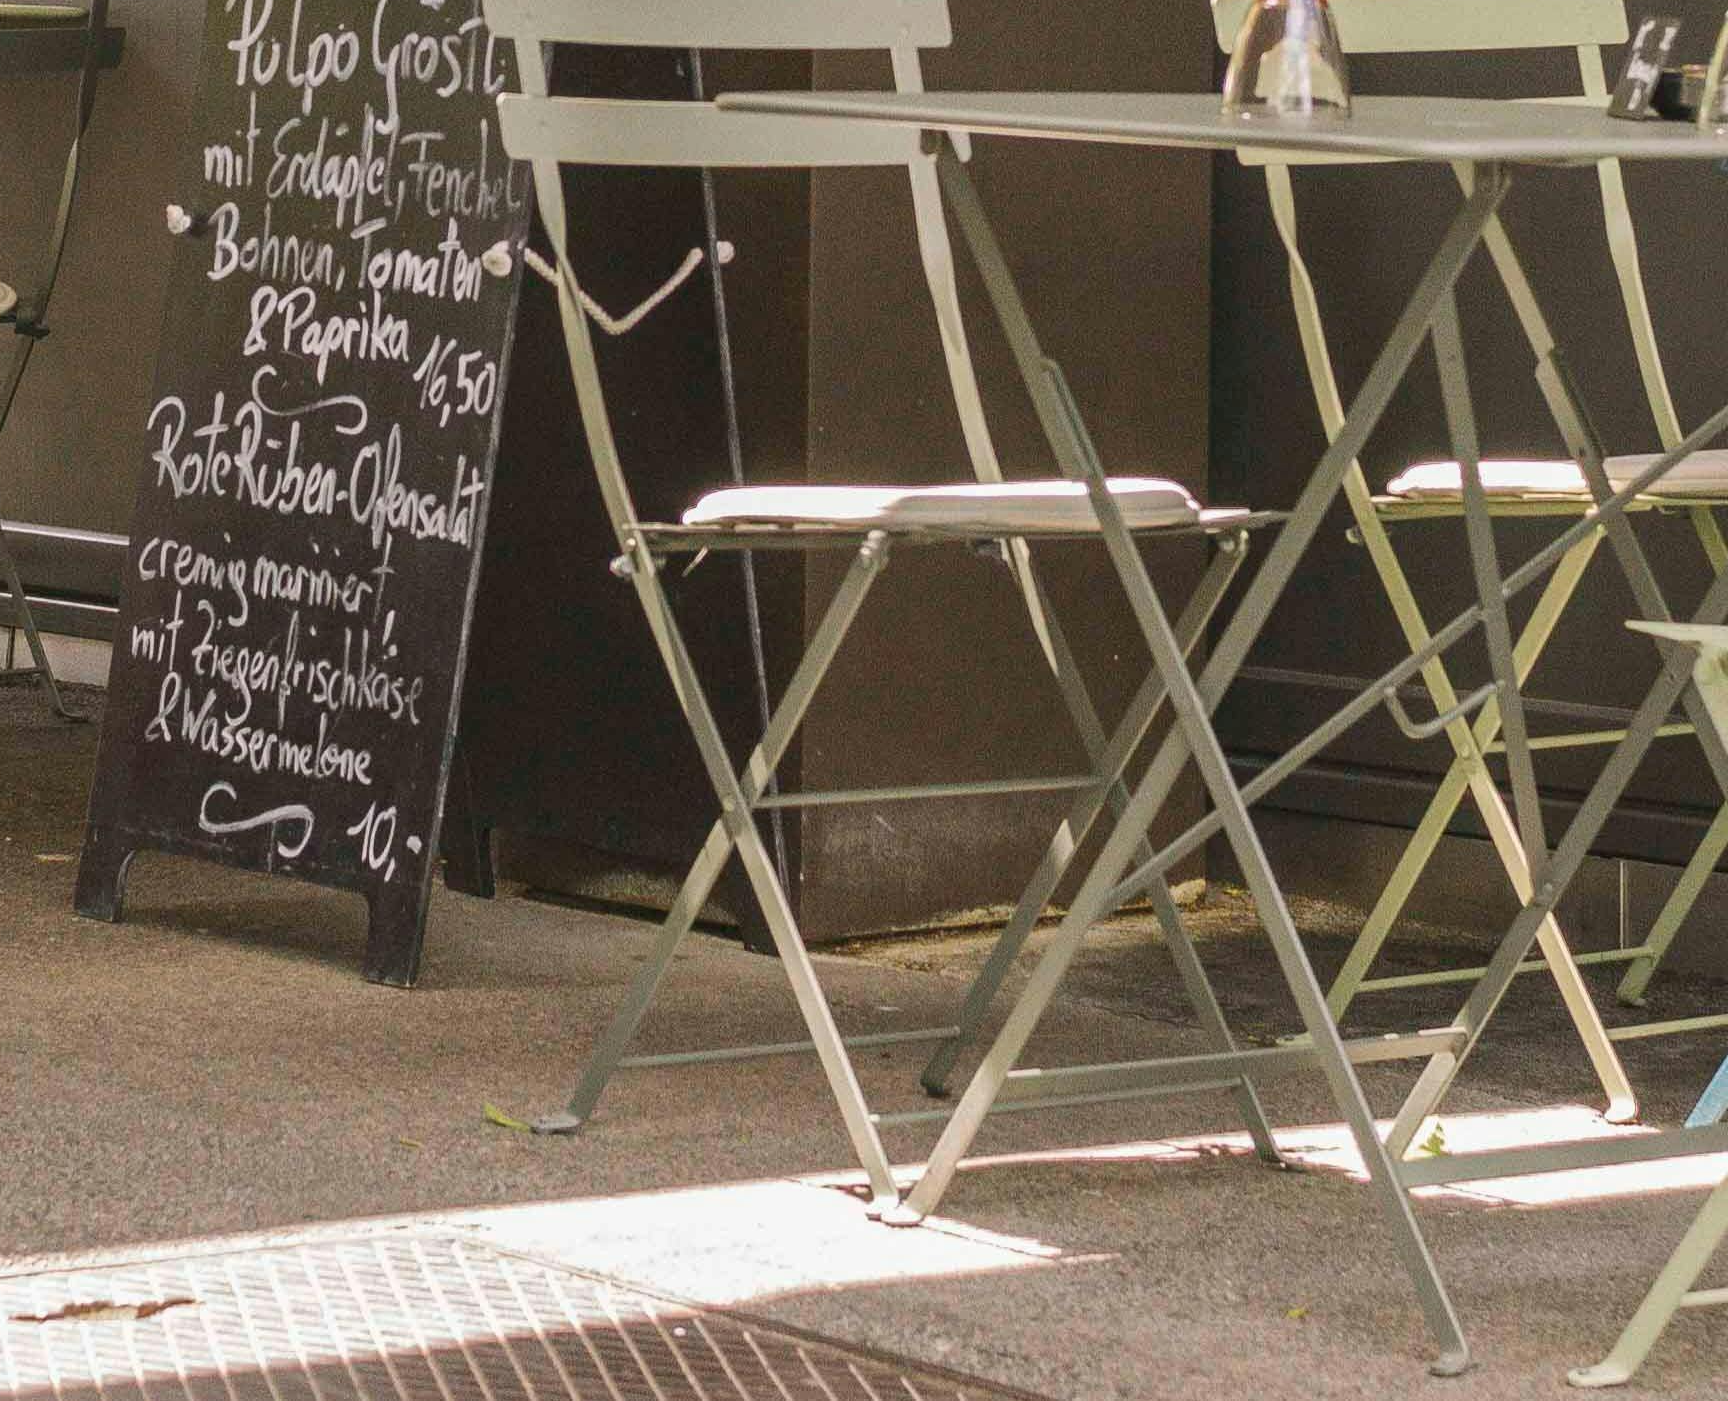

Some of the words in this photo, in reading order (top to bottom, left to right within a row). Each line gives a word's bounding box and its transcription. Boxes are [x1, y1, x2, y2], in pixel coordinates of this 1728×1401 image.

[204, 92, 261, 187] mit
[207, 201, 346, 292] Bohnen,
[350, 217, 483, 302] Tomaten
[413, 334, 497, 428] 16,50
[147, 391, 230, 499] Rote
[139, 531, 247, 627] cremig
[132, 589, 184, 671] mit
